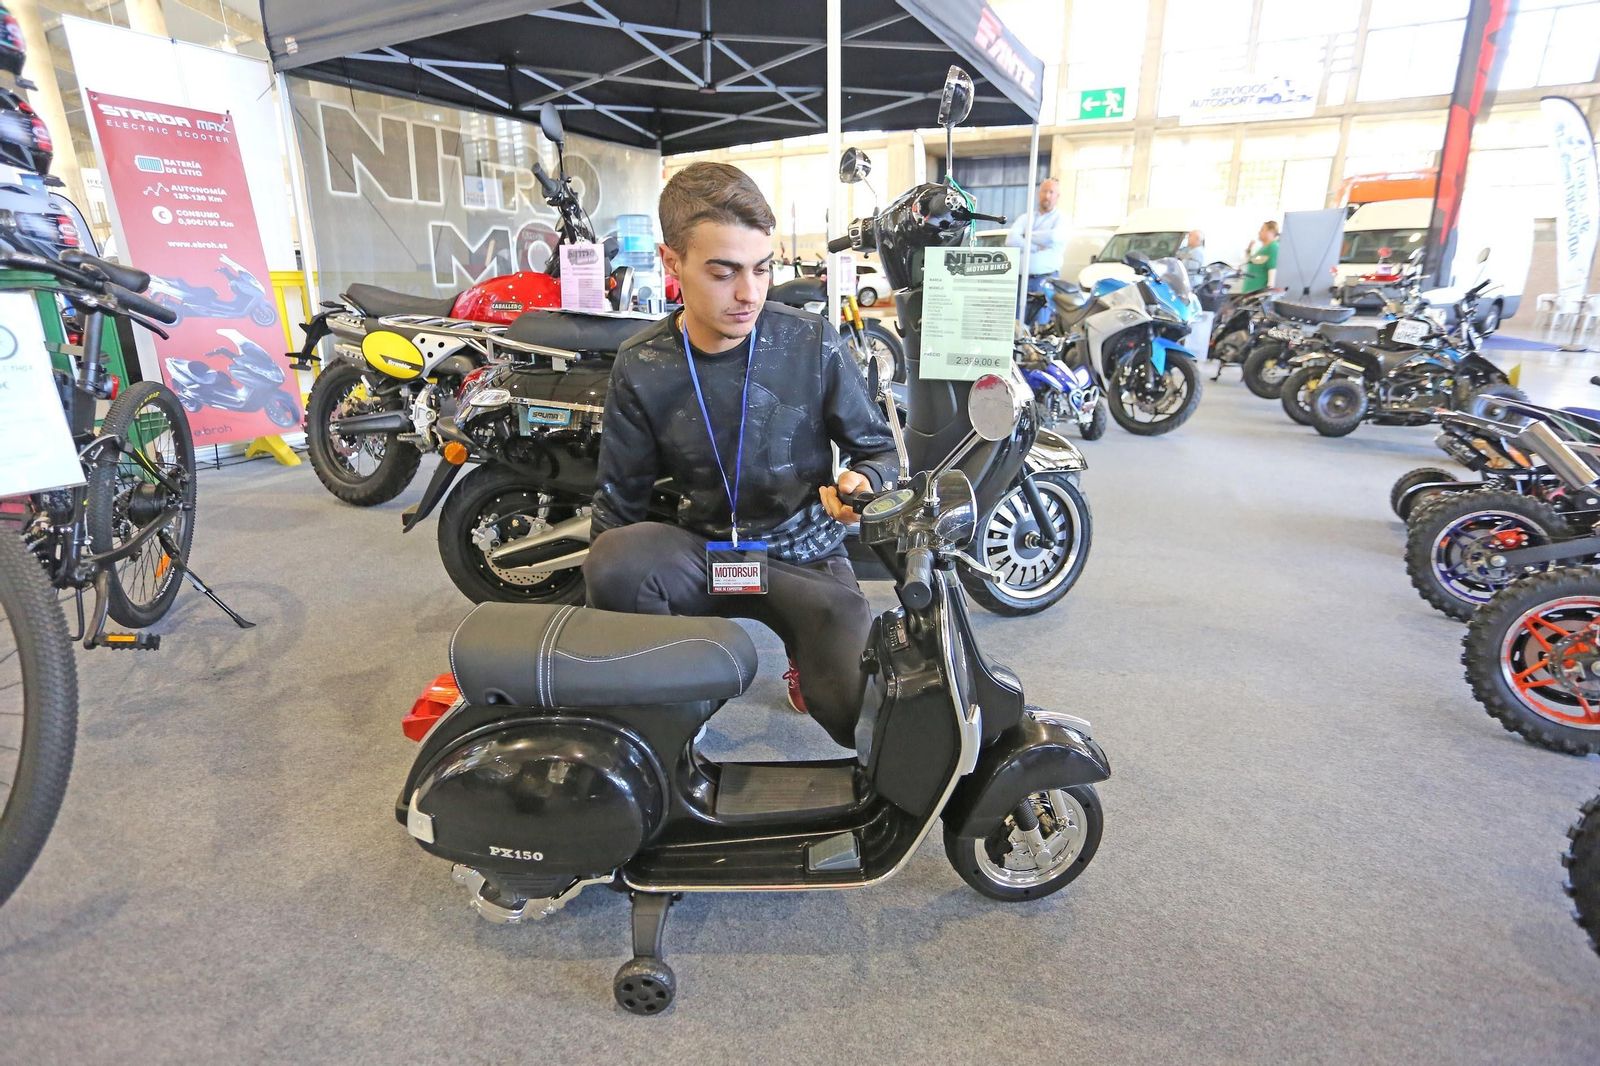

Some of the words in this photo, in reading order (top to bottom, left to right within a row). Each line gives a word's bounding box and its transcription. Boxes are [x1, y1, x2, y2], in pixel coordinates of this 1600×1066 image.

[1210, 84, 1267, 98] SERVICIOS
[1190, 95, 1256, 107] AUTOSPORT
[97, 103, 192, 128] STRADA
[196, 119, 231, 134] MAX
[106, 119, 169, 135] ELECTRIC
[177, 130, 230, 144] SCOOTER
[163, 158, 202, 170] BATERÍA
[316, 100, 602, 219] NITRO
[179, 169, 203, 177] LITIO
[171, 185, 228, 196] AUTONOMÍA
[208, 195, 223, 203] Km
[175, 209, 220, 219] CONSUMO
[220, 220, 235, 228] Km
[167, 240, 228, 250] www.ebroh.es
[945, 250, 1007, 266] NITRO
[965, 265, 989, 274] MOTOR
[989, 263, 1010, 272] BIKES
[994, 358, 1001, 367] €
[714, 566, 758, 578] MOTORSUR
[489, 846, 544, 862] PX150
